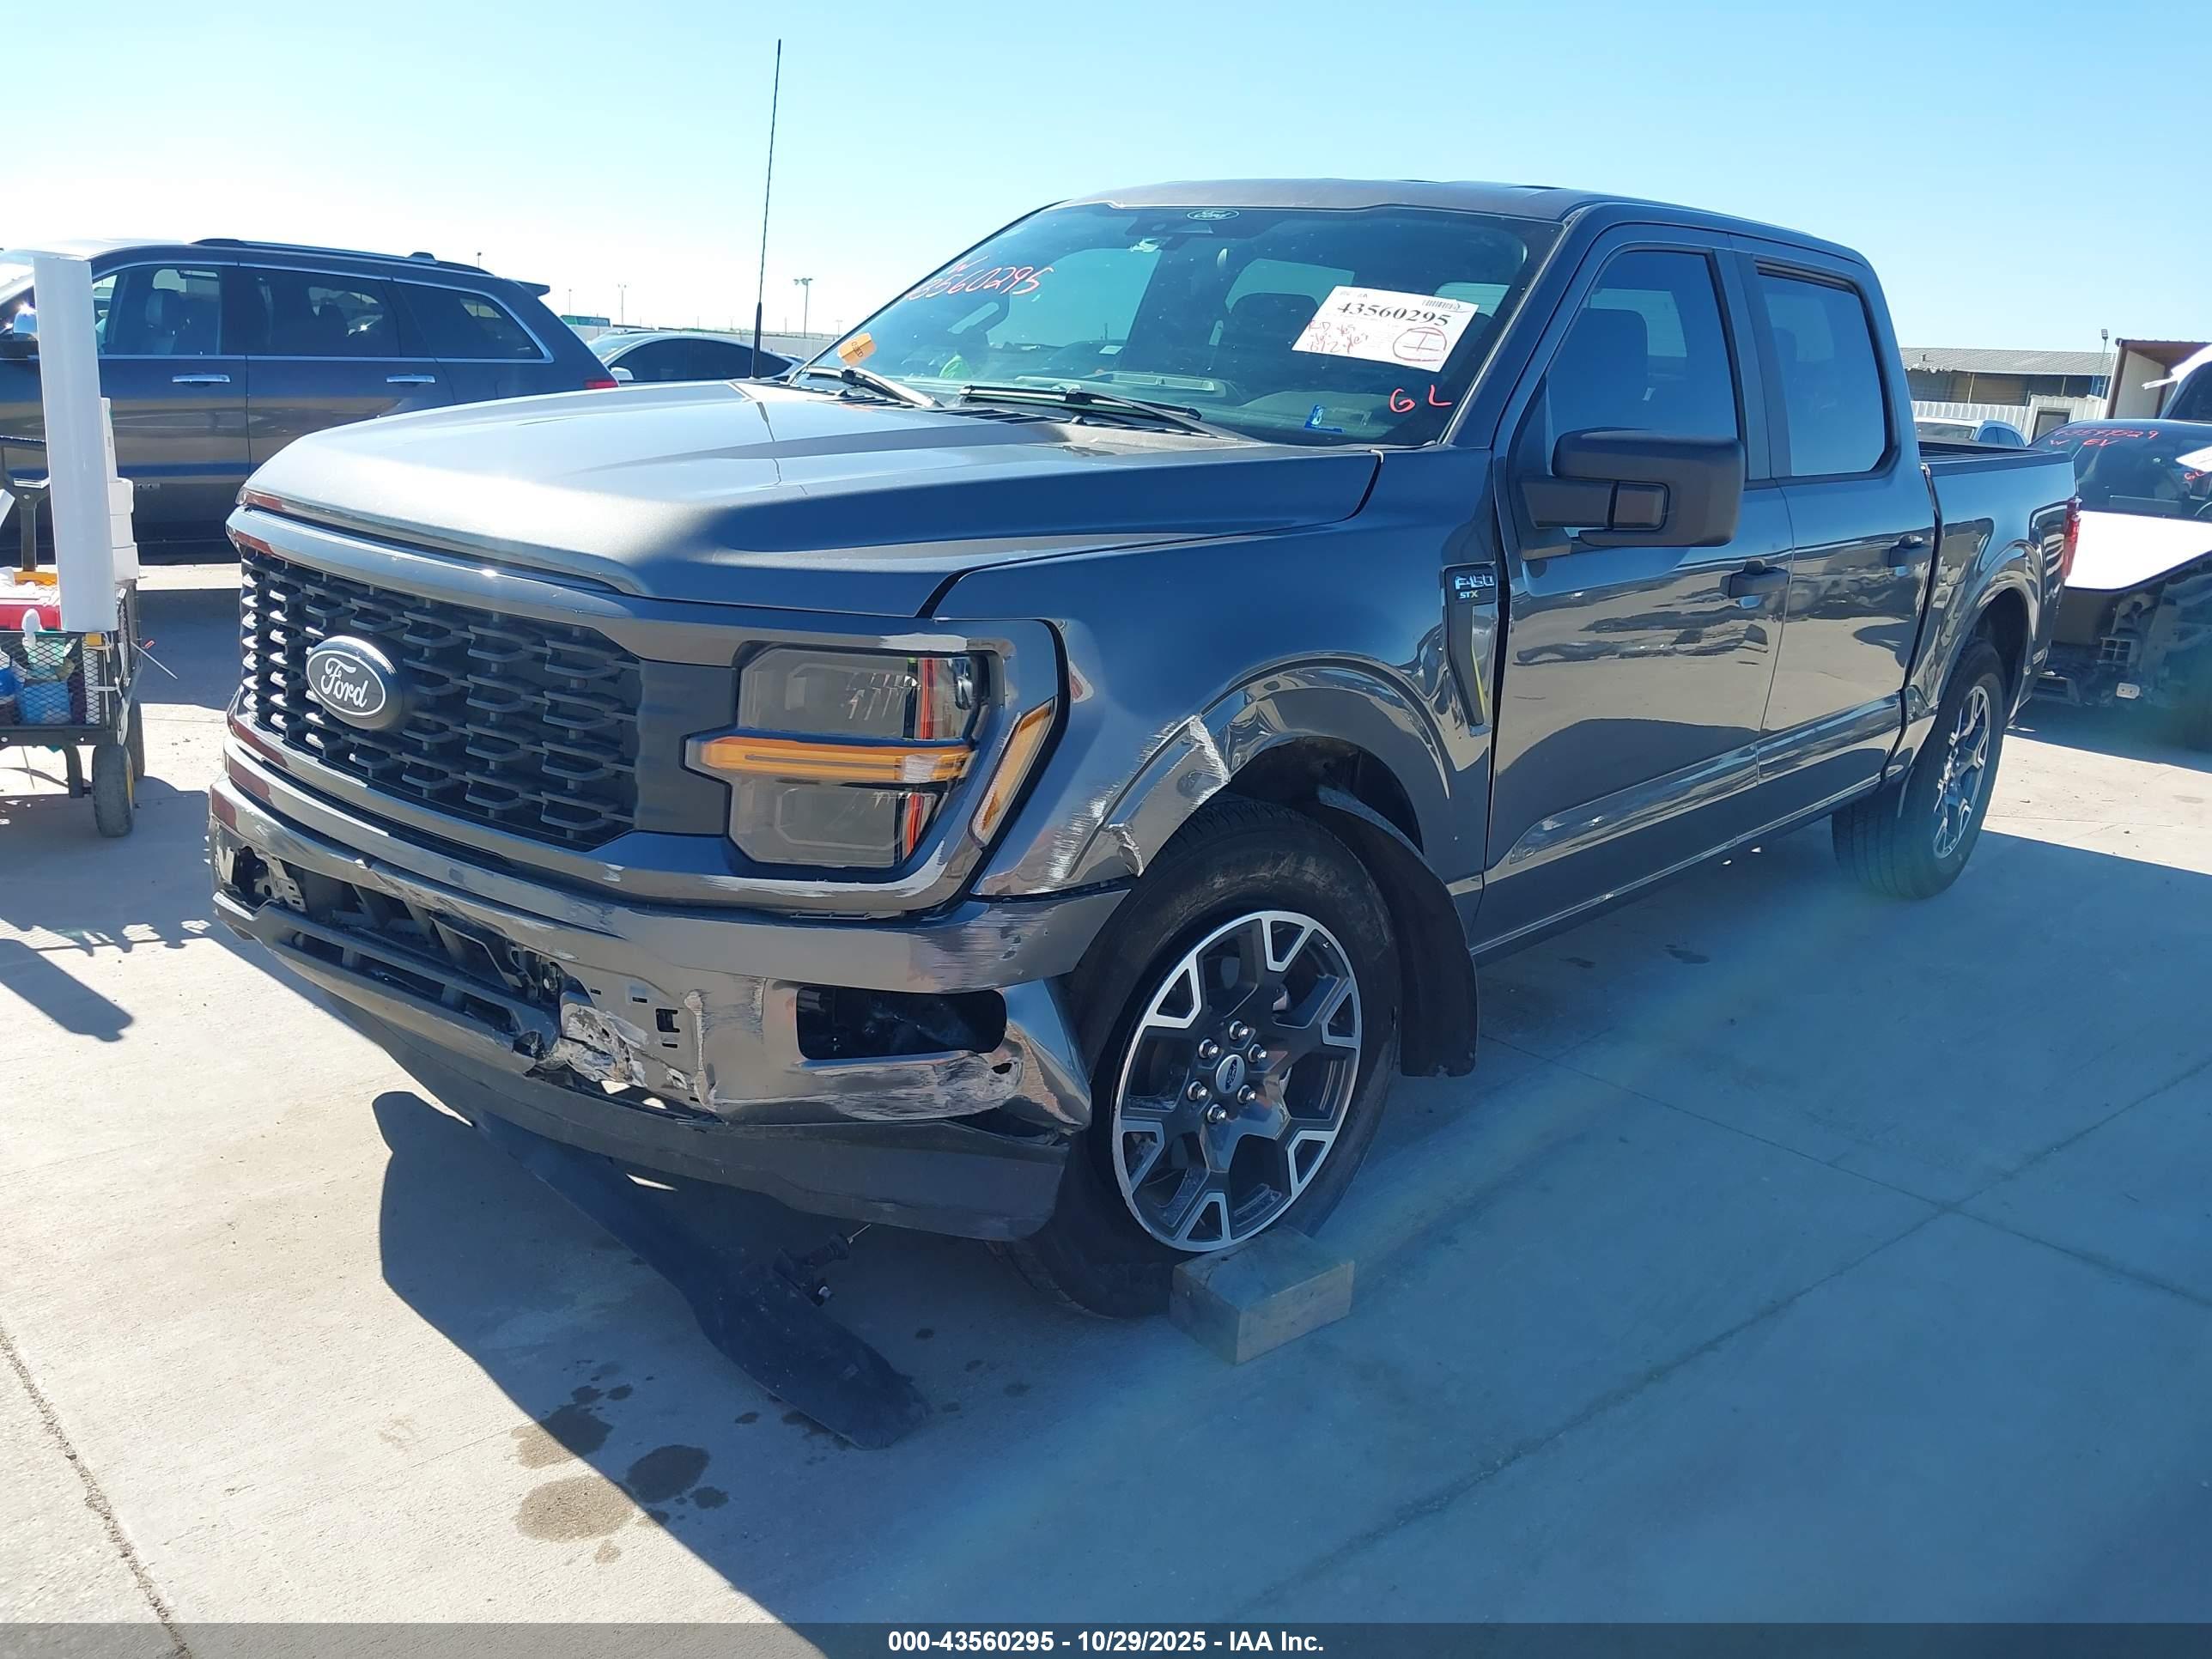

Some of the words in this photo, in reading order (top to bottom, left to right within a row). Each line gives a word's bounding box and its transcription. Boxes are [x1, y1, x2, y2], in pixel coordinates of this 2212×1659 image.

[1337, 301, 1452, 327] 43560295
[1459, 590, 1479, 599] STX
[320, 657, 369, 708] Ford
